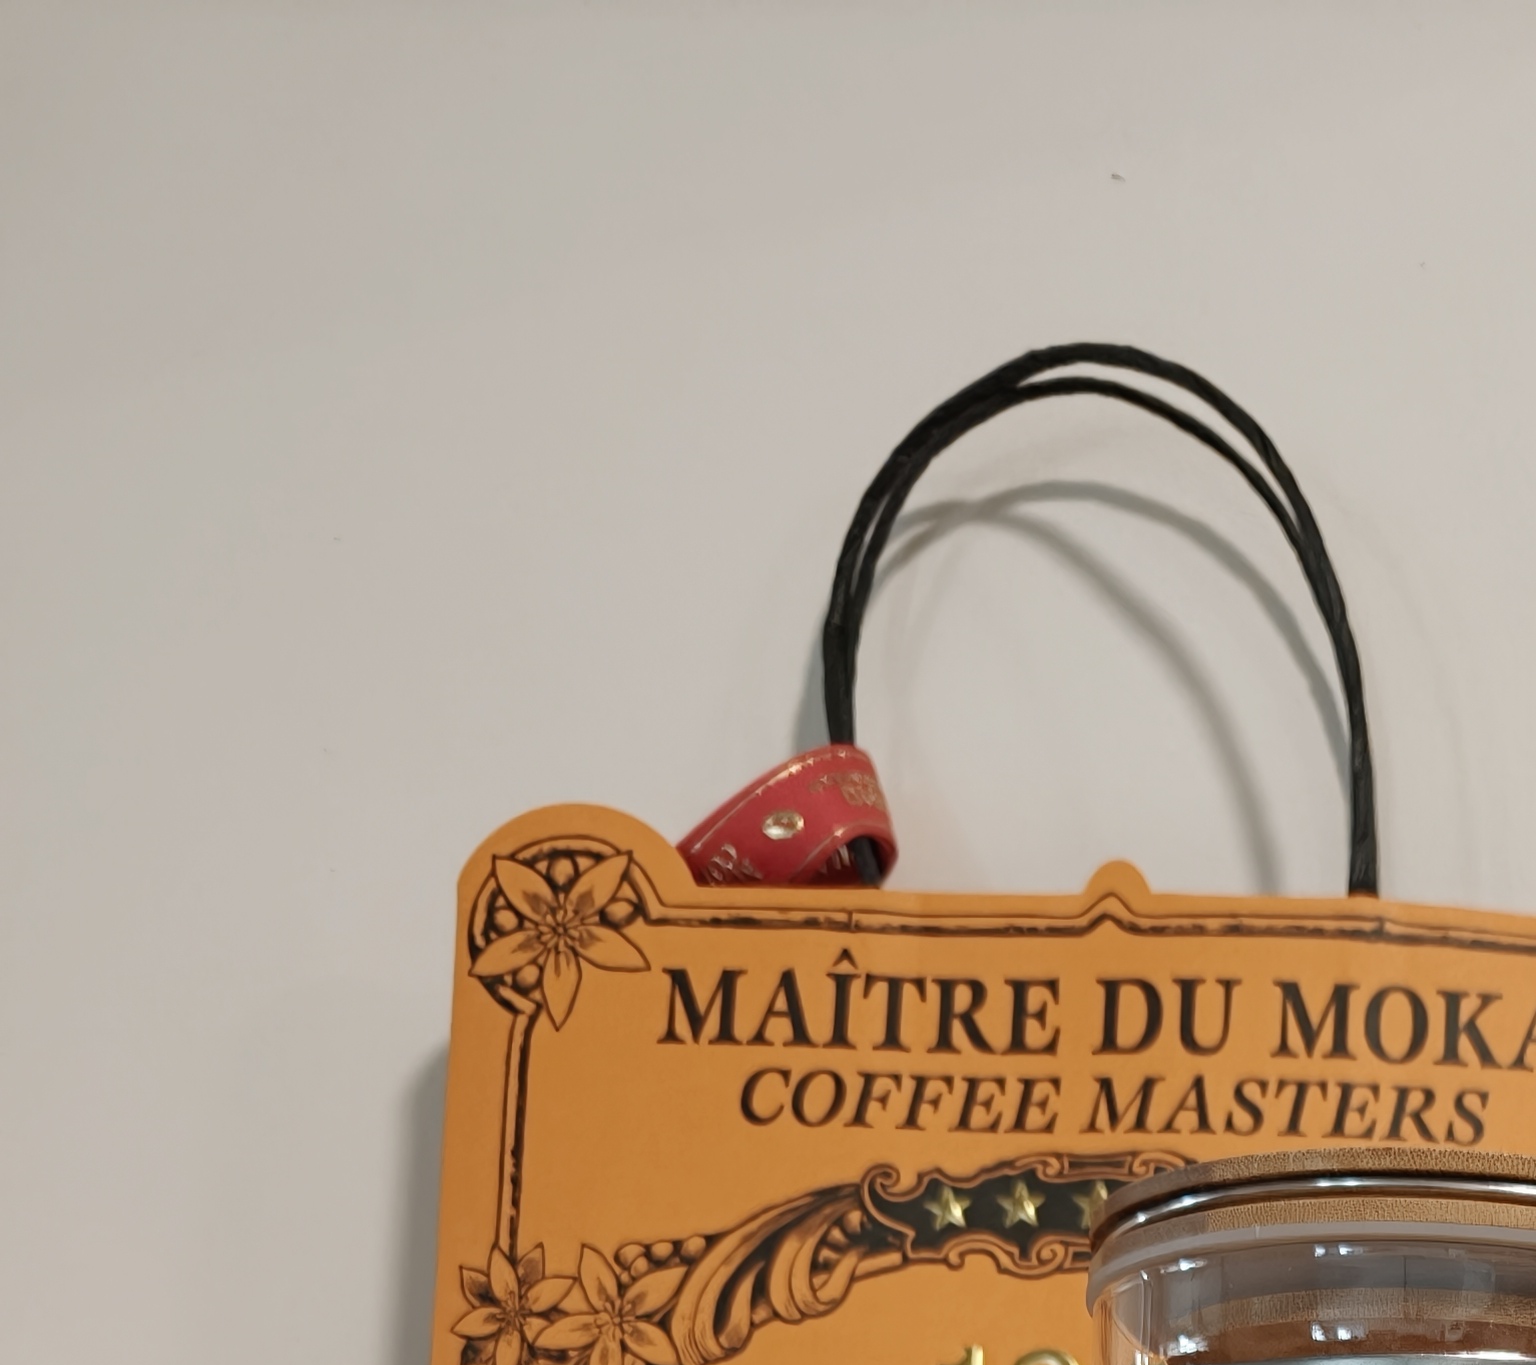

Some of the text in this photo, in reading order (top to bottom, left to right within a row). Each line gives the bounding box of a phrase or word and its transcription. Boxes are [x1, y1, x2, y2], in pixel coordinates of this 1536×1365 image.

[656, 947, 1062, 1057] MAÎTRE
[1091, 977, 1242, 1056] DU
[739, 1066, 1490, 1147] COFFEE MASTERS
